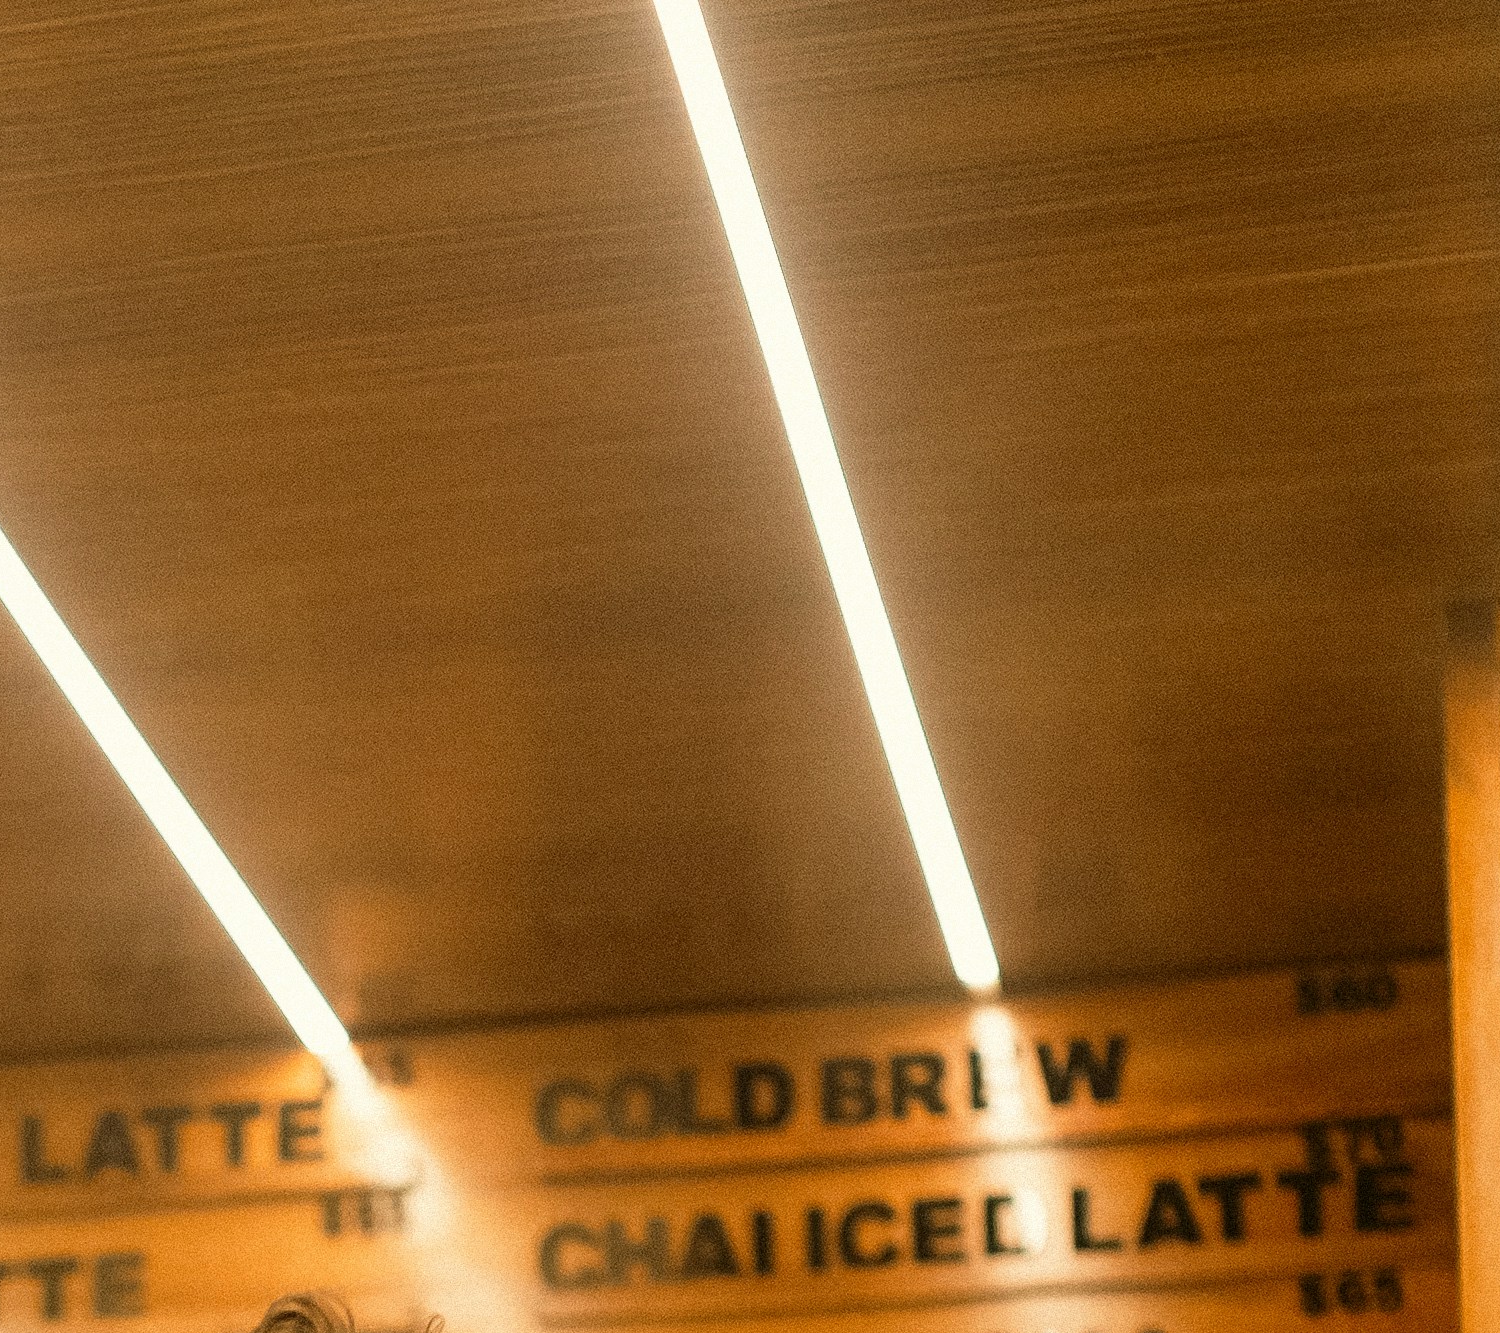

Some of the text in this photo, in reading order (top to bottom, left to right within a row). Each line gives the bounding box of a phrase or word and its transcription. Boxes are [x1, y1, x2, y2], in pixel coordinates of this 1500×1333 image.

[20, 1100, 326, 1185] LATTE
[532, 1061, 794, 1148] COLD
[536, 1162, 1416, 1292] CHAI ICED LATTE
